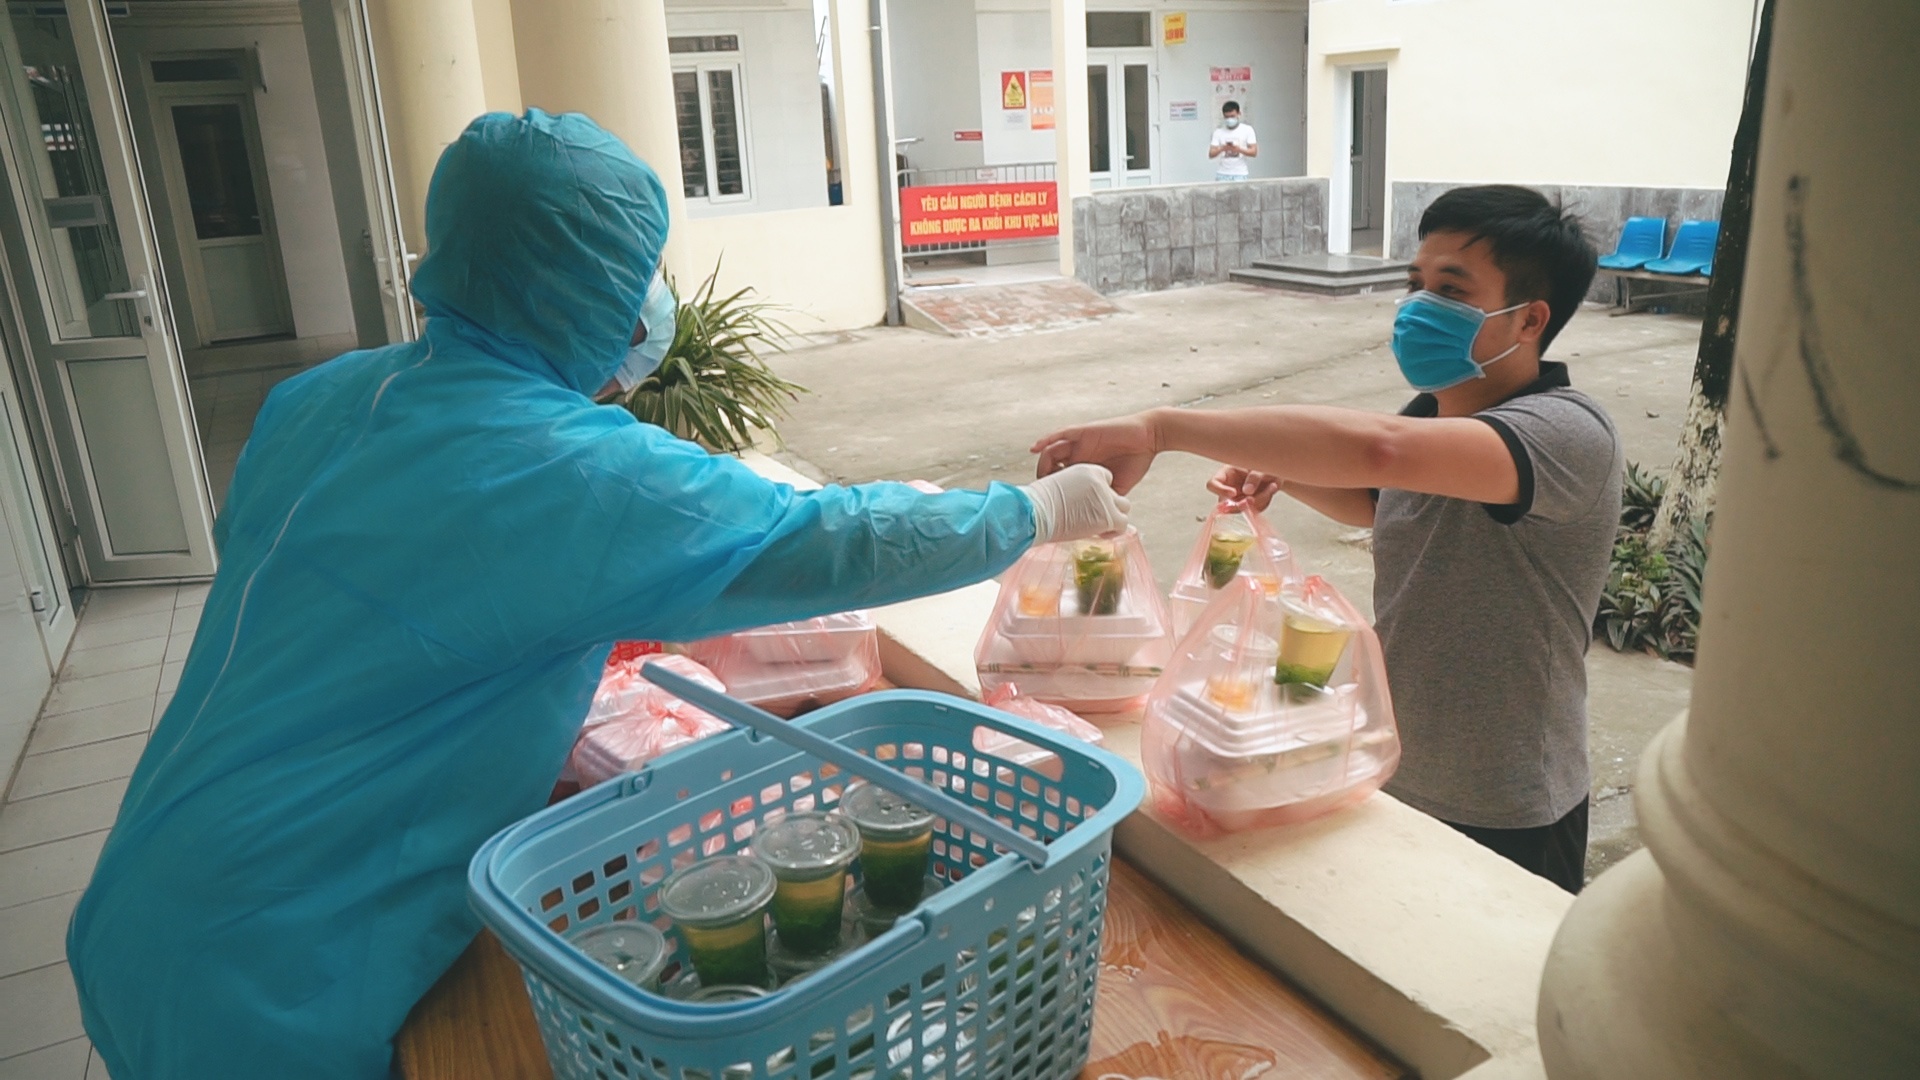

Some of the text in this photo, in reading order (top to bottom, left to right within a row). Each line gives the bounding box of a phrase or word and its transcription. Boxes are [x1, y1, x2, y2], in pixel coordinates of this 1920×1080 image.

[920, 194, 938, 212] YÊU
[989, 190, 1012, 210] BỆNH
[1013, 189, 1037, 207] CÁCH
[1037, 191, 1048, 206] LY
[910, 217, 942, 236] KHÔNG
[968, 217, 981, 232] RA
[981, 212, 1003, 231] KHỎI
[1004, 214, 1022, 230] KHU
[1023, 213, 1041, 231] VỰC
